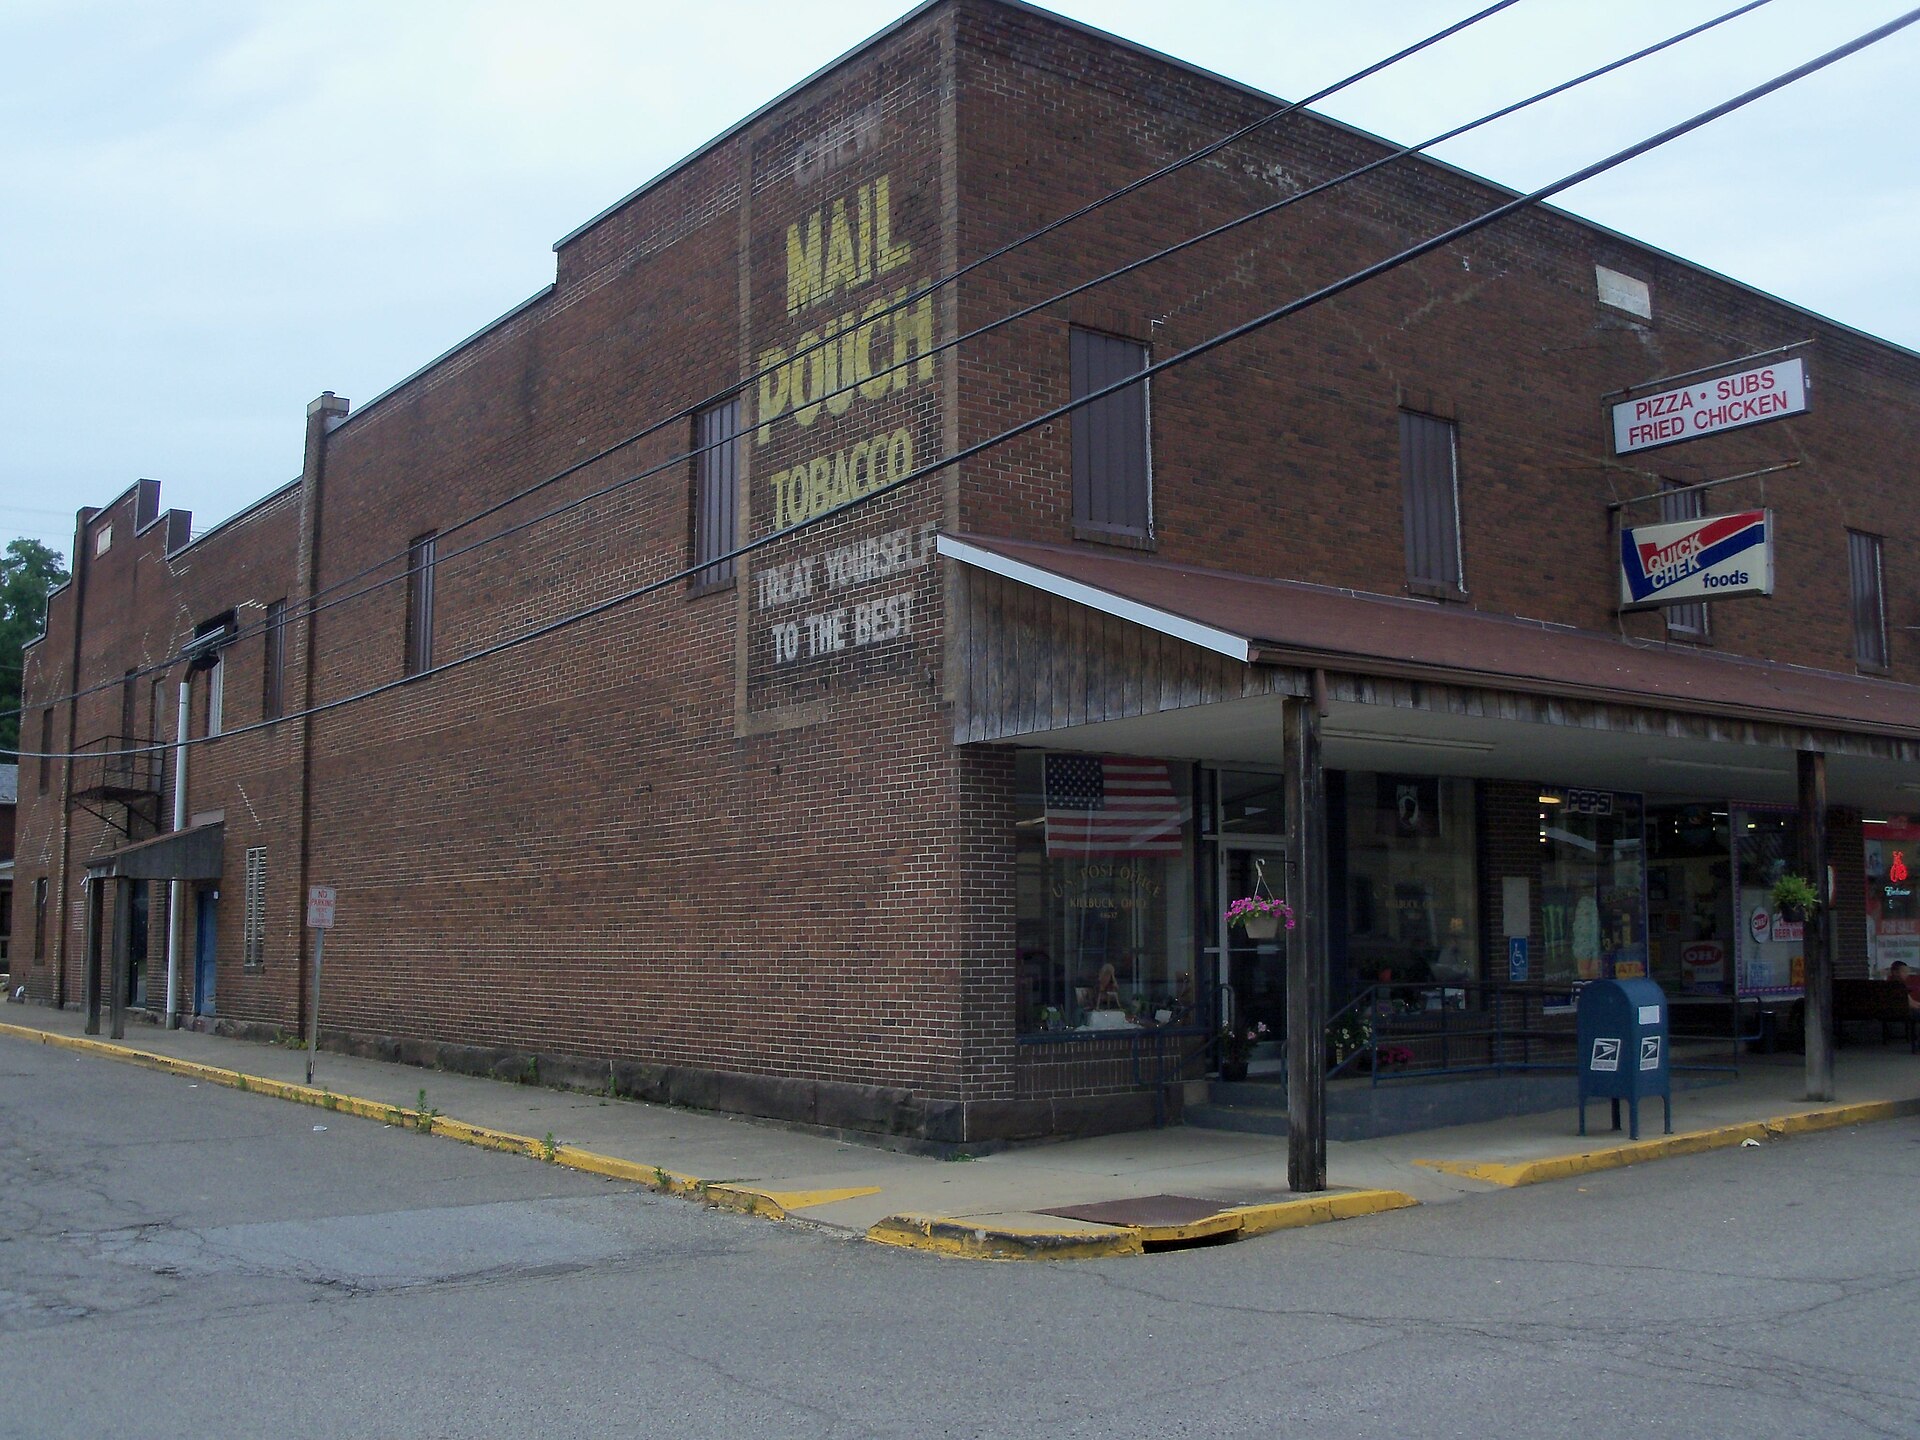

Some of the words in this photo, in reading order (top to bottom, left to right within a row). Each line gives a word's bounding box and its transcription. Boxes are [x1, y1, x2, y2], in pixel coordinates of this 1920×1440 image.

[786, 174, 911, 318] MAIL
[758, 276, 933, 445] POUCH
[1628, 417, 1685, 446] FRIED
[1694, 391, 1788, 430] CHICKEN
[1635, 391, 1694, 421] PIZZA
[1716, 370, 1775, 400] SUBS
[770, 426, 913, 531] TOBACCO
[754, 556, 818, 610] TREAT
[824, 520, 937, 591] YOURSELF
[1647, 532, 1706, 572] QUICK
[1651, 553, 1701, 589] CHEK
[1702, 570, 1749, 589] foods
[771, 621, 799, 664] TO
[804, 608, 846, 657] THE
[854, 592, 914, 646] BEST
[1566, 789, 1614, 815] PEPSI
[1080, 864, 1114, 880] POST
